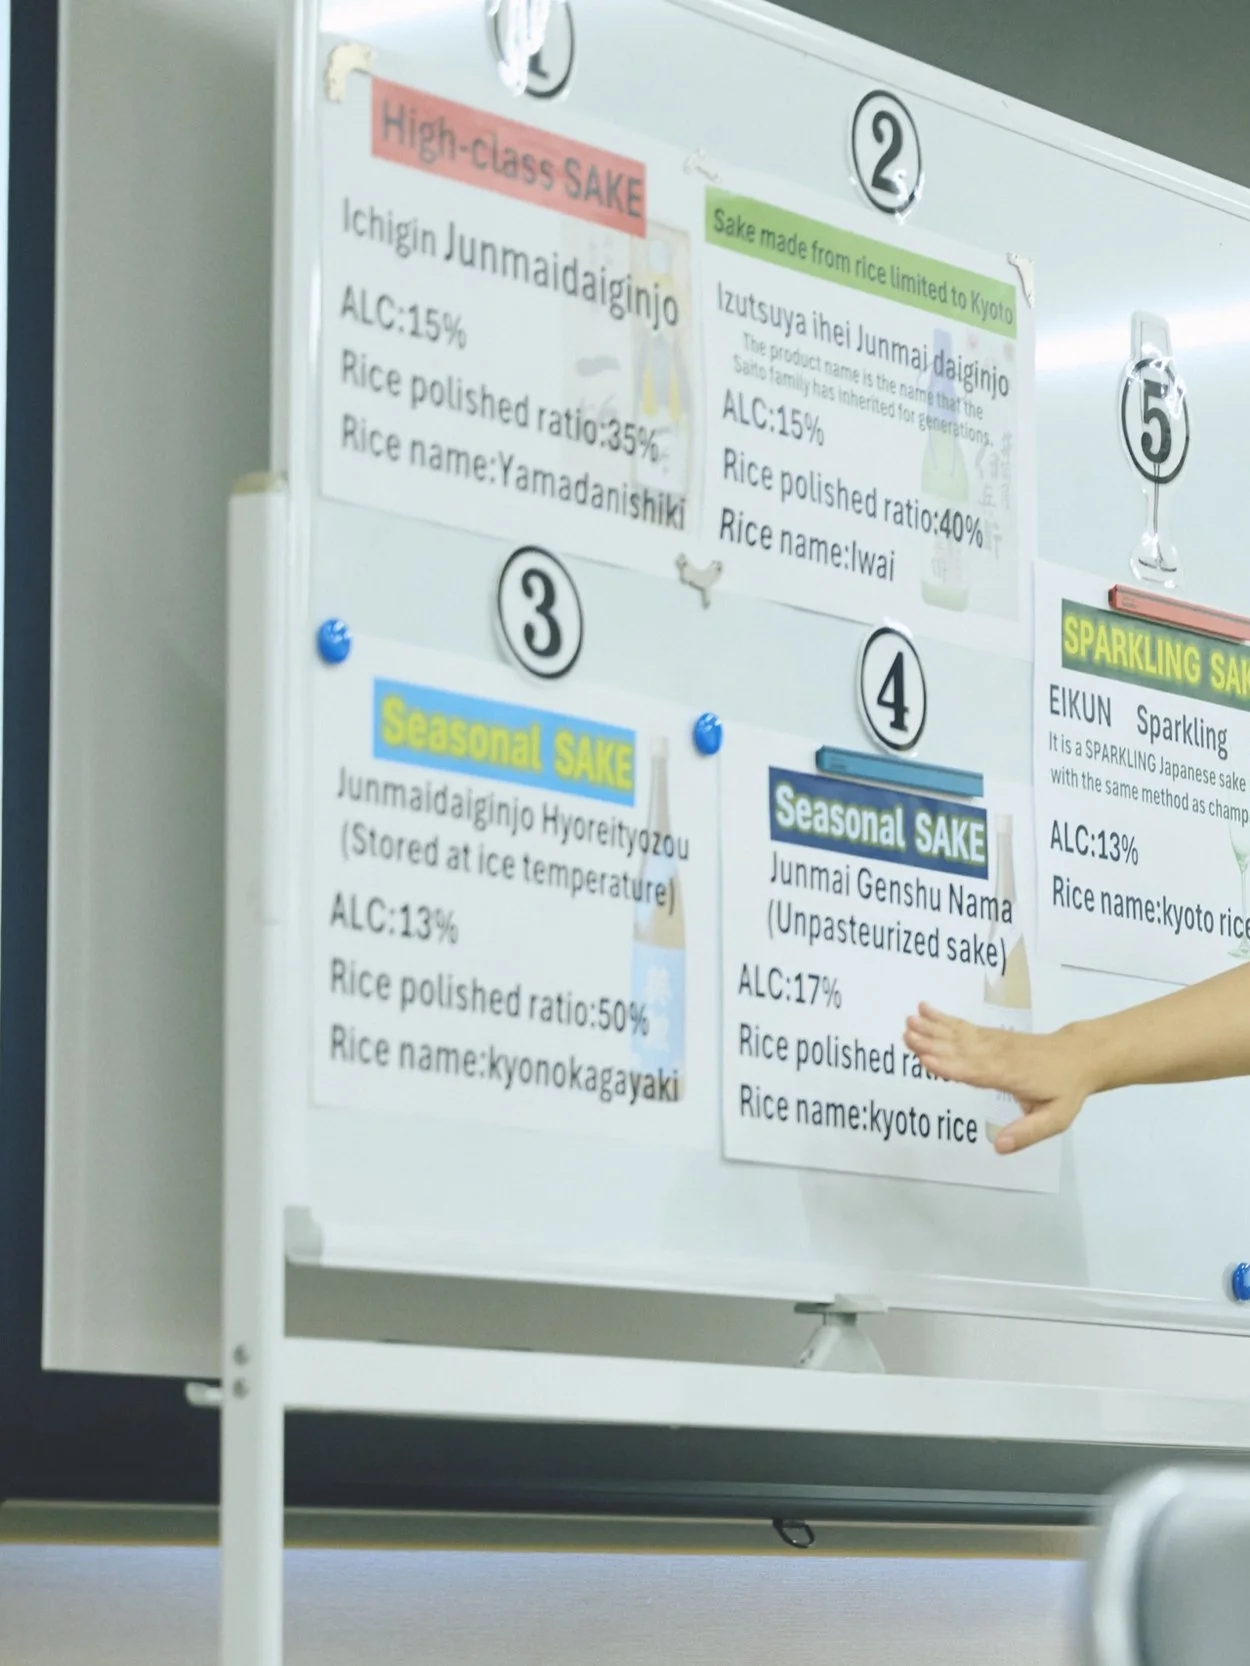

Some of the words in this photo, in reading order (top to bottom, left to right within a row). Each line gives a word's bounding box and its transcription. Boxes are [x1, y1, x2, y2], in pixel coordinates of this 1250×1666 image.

[381, 101, 554, 191] High-class
[565, 158, 644, 219] SAKE
[872, 110, 906, 194] 2
[343, 198, 436, 258] Ichigin
[444, 222, 678, 330] Junmaidaiginjo
[713, 208, 755, 243] Sake
[760, 226, 807, 257] made
[811, 240, 850, 274] from
[855, 256, 886, 285] rice
[890, 264, 947, 304] limited
[951, 285, 968, 311] to
[971, 294, 1013, 326] Kyoto
[340, 284, 467, 350] ALC:15%
[717, 282, 806, 338] Izutsuya
[813, 310, 851, 349] ihei
[857, 324, 927, 371] Junmai
[934, 349, 1009, 399] daiginjo
[342, 349, 401, 397] Rice
[410, 376, 528, 428] polished
[537, 401, 659, 463] ratio:35%
[734, 354, 766, 380] Saito
[769, 364, 809, 398] family
[813, 379, 834, 401] has
[838, 387, 895, 418] inherited
[898, 402, 915, 422] for
[918, 411, 993, 447] generations.
[743, 332, 766, 356] The
[770, 343, 821, 372] product
[825, 363, 859, 384] name
[862, 368, 873, 387] is
[877, 371, 896, 393] the
[900, 383, 933, 406] name
[936, 391, 960, 412] that
[964, 400, 983, 420] the
[723, 388, 824, 446] ALC:15%
[1141, 380, 1173, 464] 5
[341, 413, 401, 461] Rice
[410, 438, 685, 530] name:Yamadanishiki
[724, 447, 772, 490] Rice
[781, 469, 877, 519] polished
[884, 499, 983, 548] ratio:40%
[720, 508, 772, 550] Rice
[780, 530, 894, 581] name:Iwai
[521, 568, 562, 658] 3
[1064, 615, 1200, 682] SPARKLING
[877, 651, 909, 732] 4
[1050, 684, 1112, 727] EIKUN
[1137, 704, 1228, 760] Sparkling
[380, 694, 543, 771] Seasonal
[554, 729, 633, 790] SAKE
[1050, 731, 1058, 751] It
[1061, 736, 1071, 755] is
[1075, 743, 1082, 756] a
[1085, 739, 1156, 773] SPARKLING
[1159, 755, 1216, 785] Japanese
[1219, 770, 1246, 792] sake
[338, 767, 534, 837] Junmaidaiginjo
[775, 784, 906, 848] Seasonal
[915, 813, 985, 863] SAKE
[1051, 767, 1078, 788] with
[1082, 772, 1102, 792] the
[1105, 779, 1138, 800] same
[1142, 783, 1189, 811] method
[1192, 798, 1206, 815] as
[341, 821, 438, 866] (Stored
[446, 847, 470, 874] at
[478, 849, 515, 880] ice
[523, 856, 675, 916] temperature)
[1051, 819, 1139, 866] ALC:13%
[330, 892, 459, 944] ALC:13%
[771, 851, 850, 897] Junmai
[857, 867, 940, 912] Genshu
[949, 883, 1013, 924] Nama
[1053, 875, 1095, 912] Rice
[1101, 890, 1214, 935] name:kyoto
[768, 900, 939, 958] (Unpasteurized
[947, 934, 1007, 976] sake)
[330, 957, 391, 1001] Rice
[400, 974, 521, 1017] polished
[528, 991, 650, 1036] ratio:50%
[738, 963, 842, 1009] ALC:17%
[330, 1024, 390, 1066] Rice
[400, 1039, 680, 1104] name:kyonokagayaki
[739, 1023, 788, 1062] Rice
[796, 1034, 895, 1075] polished
[739, 1084, 788, 1122] Rice
[796, 1095, 930, 1141] name:kyoto
[937, 1110, 978, 1143] rice
